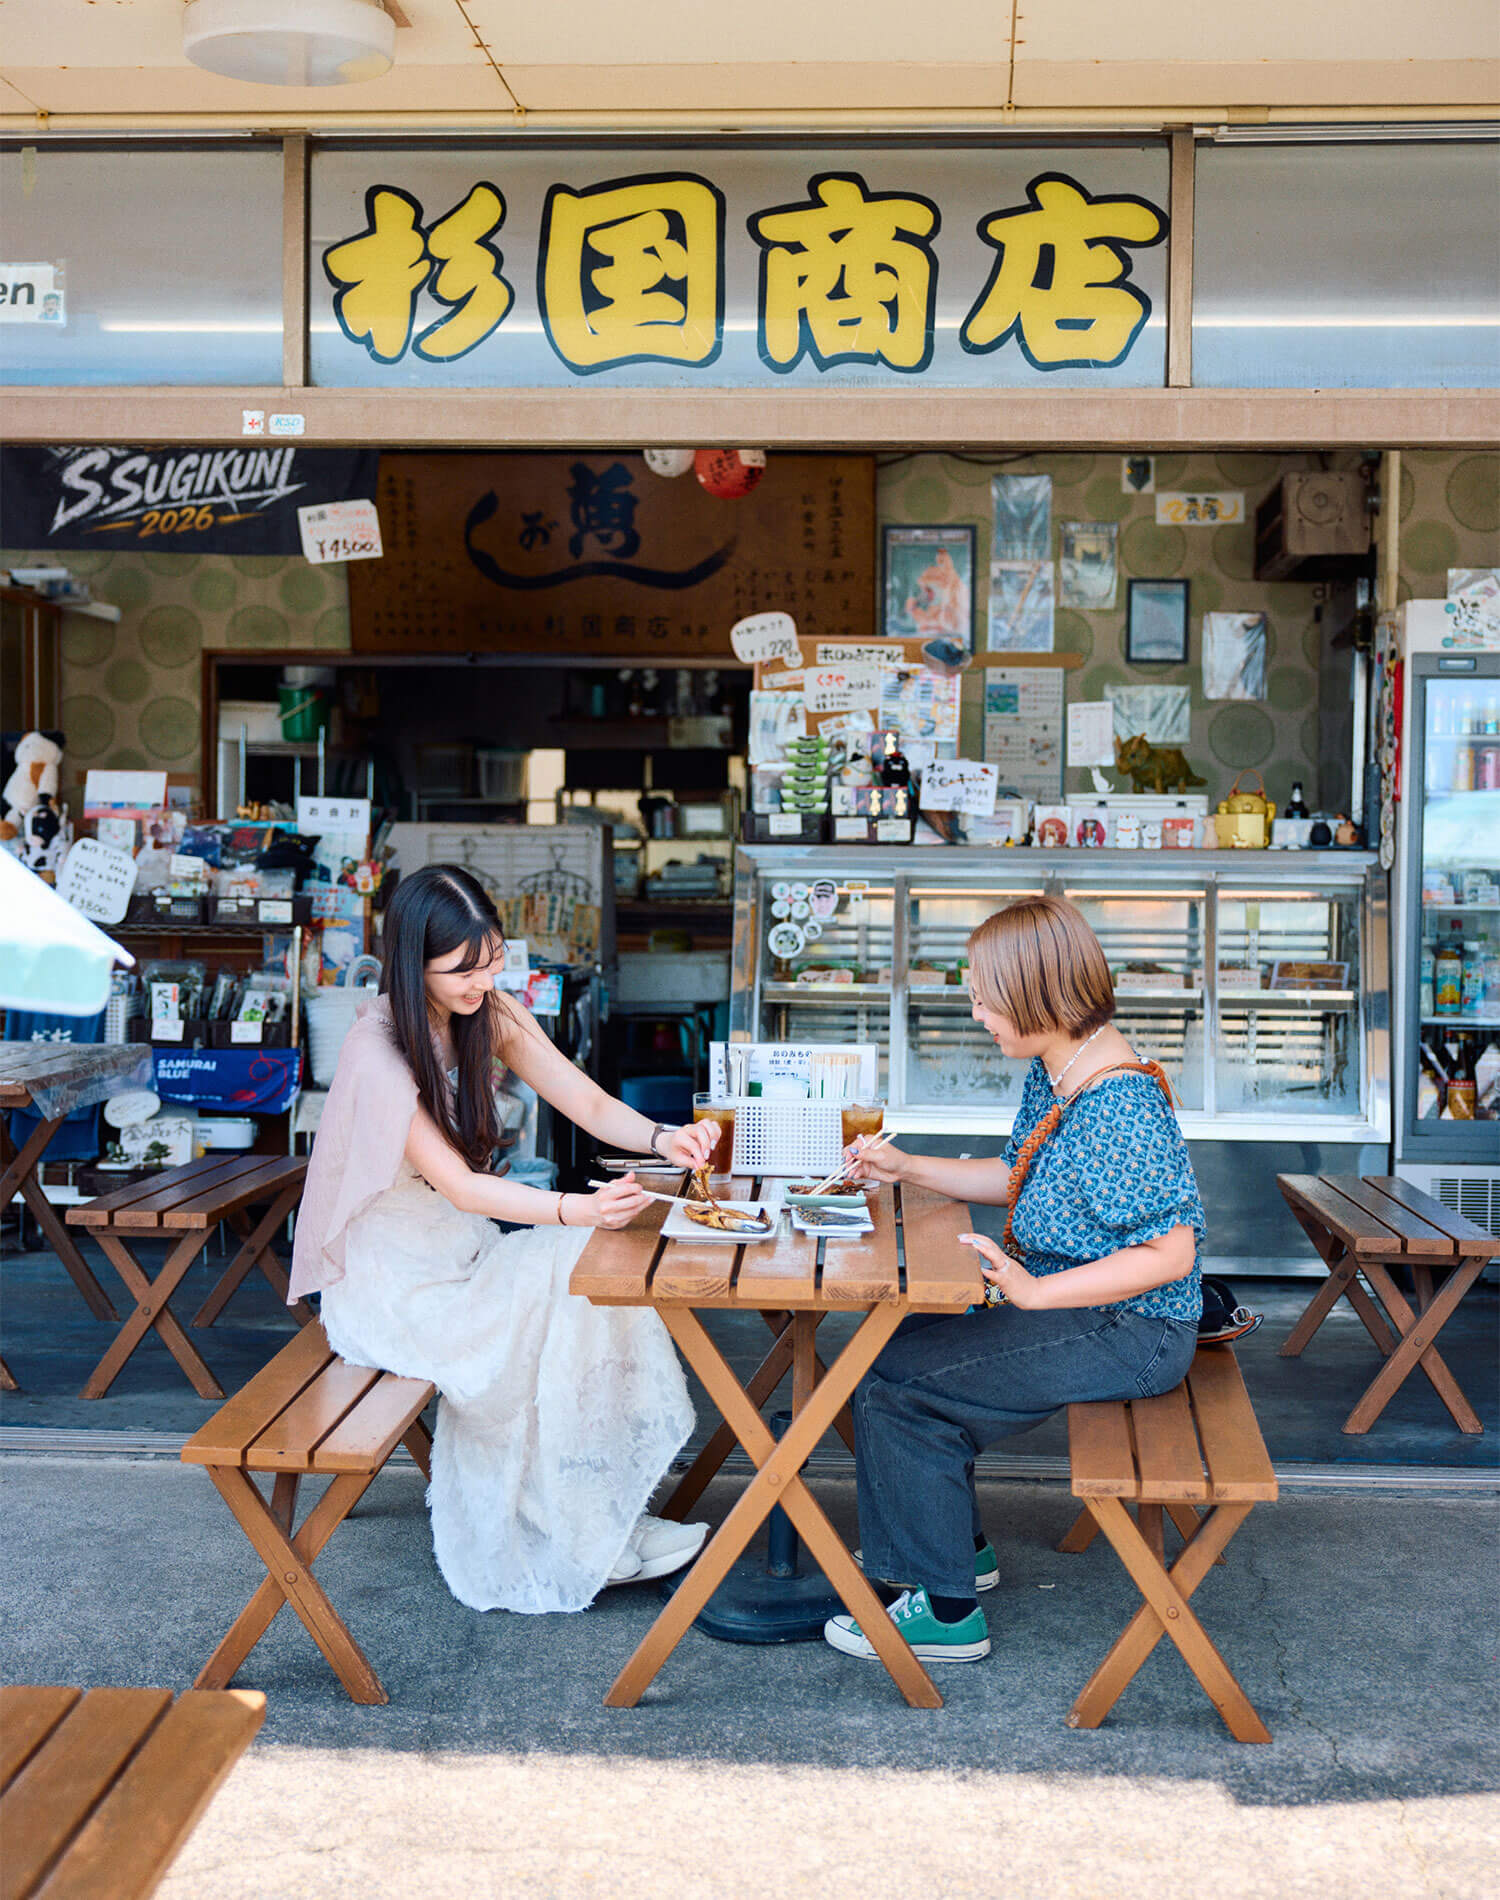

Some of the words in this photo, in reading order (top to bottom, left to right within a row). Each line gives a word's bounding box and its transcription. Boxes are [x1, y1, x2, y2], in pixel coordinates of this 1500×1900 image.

[323, 171, 1169, 374] 杉国商店
[49, 448, 304, 535] S.SUGIKUNI
[138, 505, 214, 538] 2026
[816, 674, 846, 687] くさや
[308, 806, 360, 818] お会計
[157, 1058, 217, 1071] SAMURAI
[157, 1070, 191, 1080] BLUE
